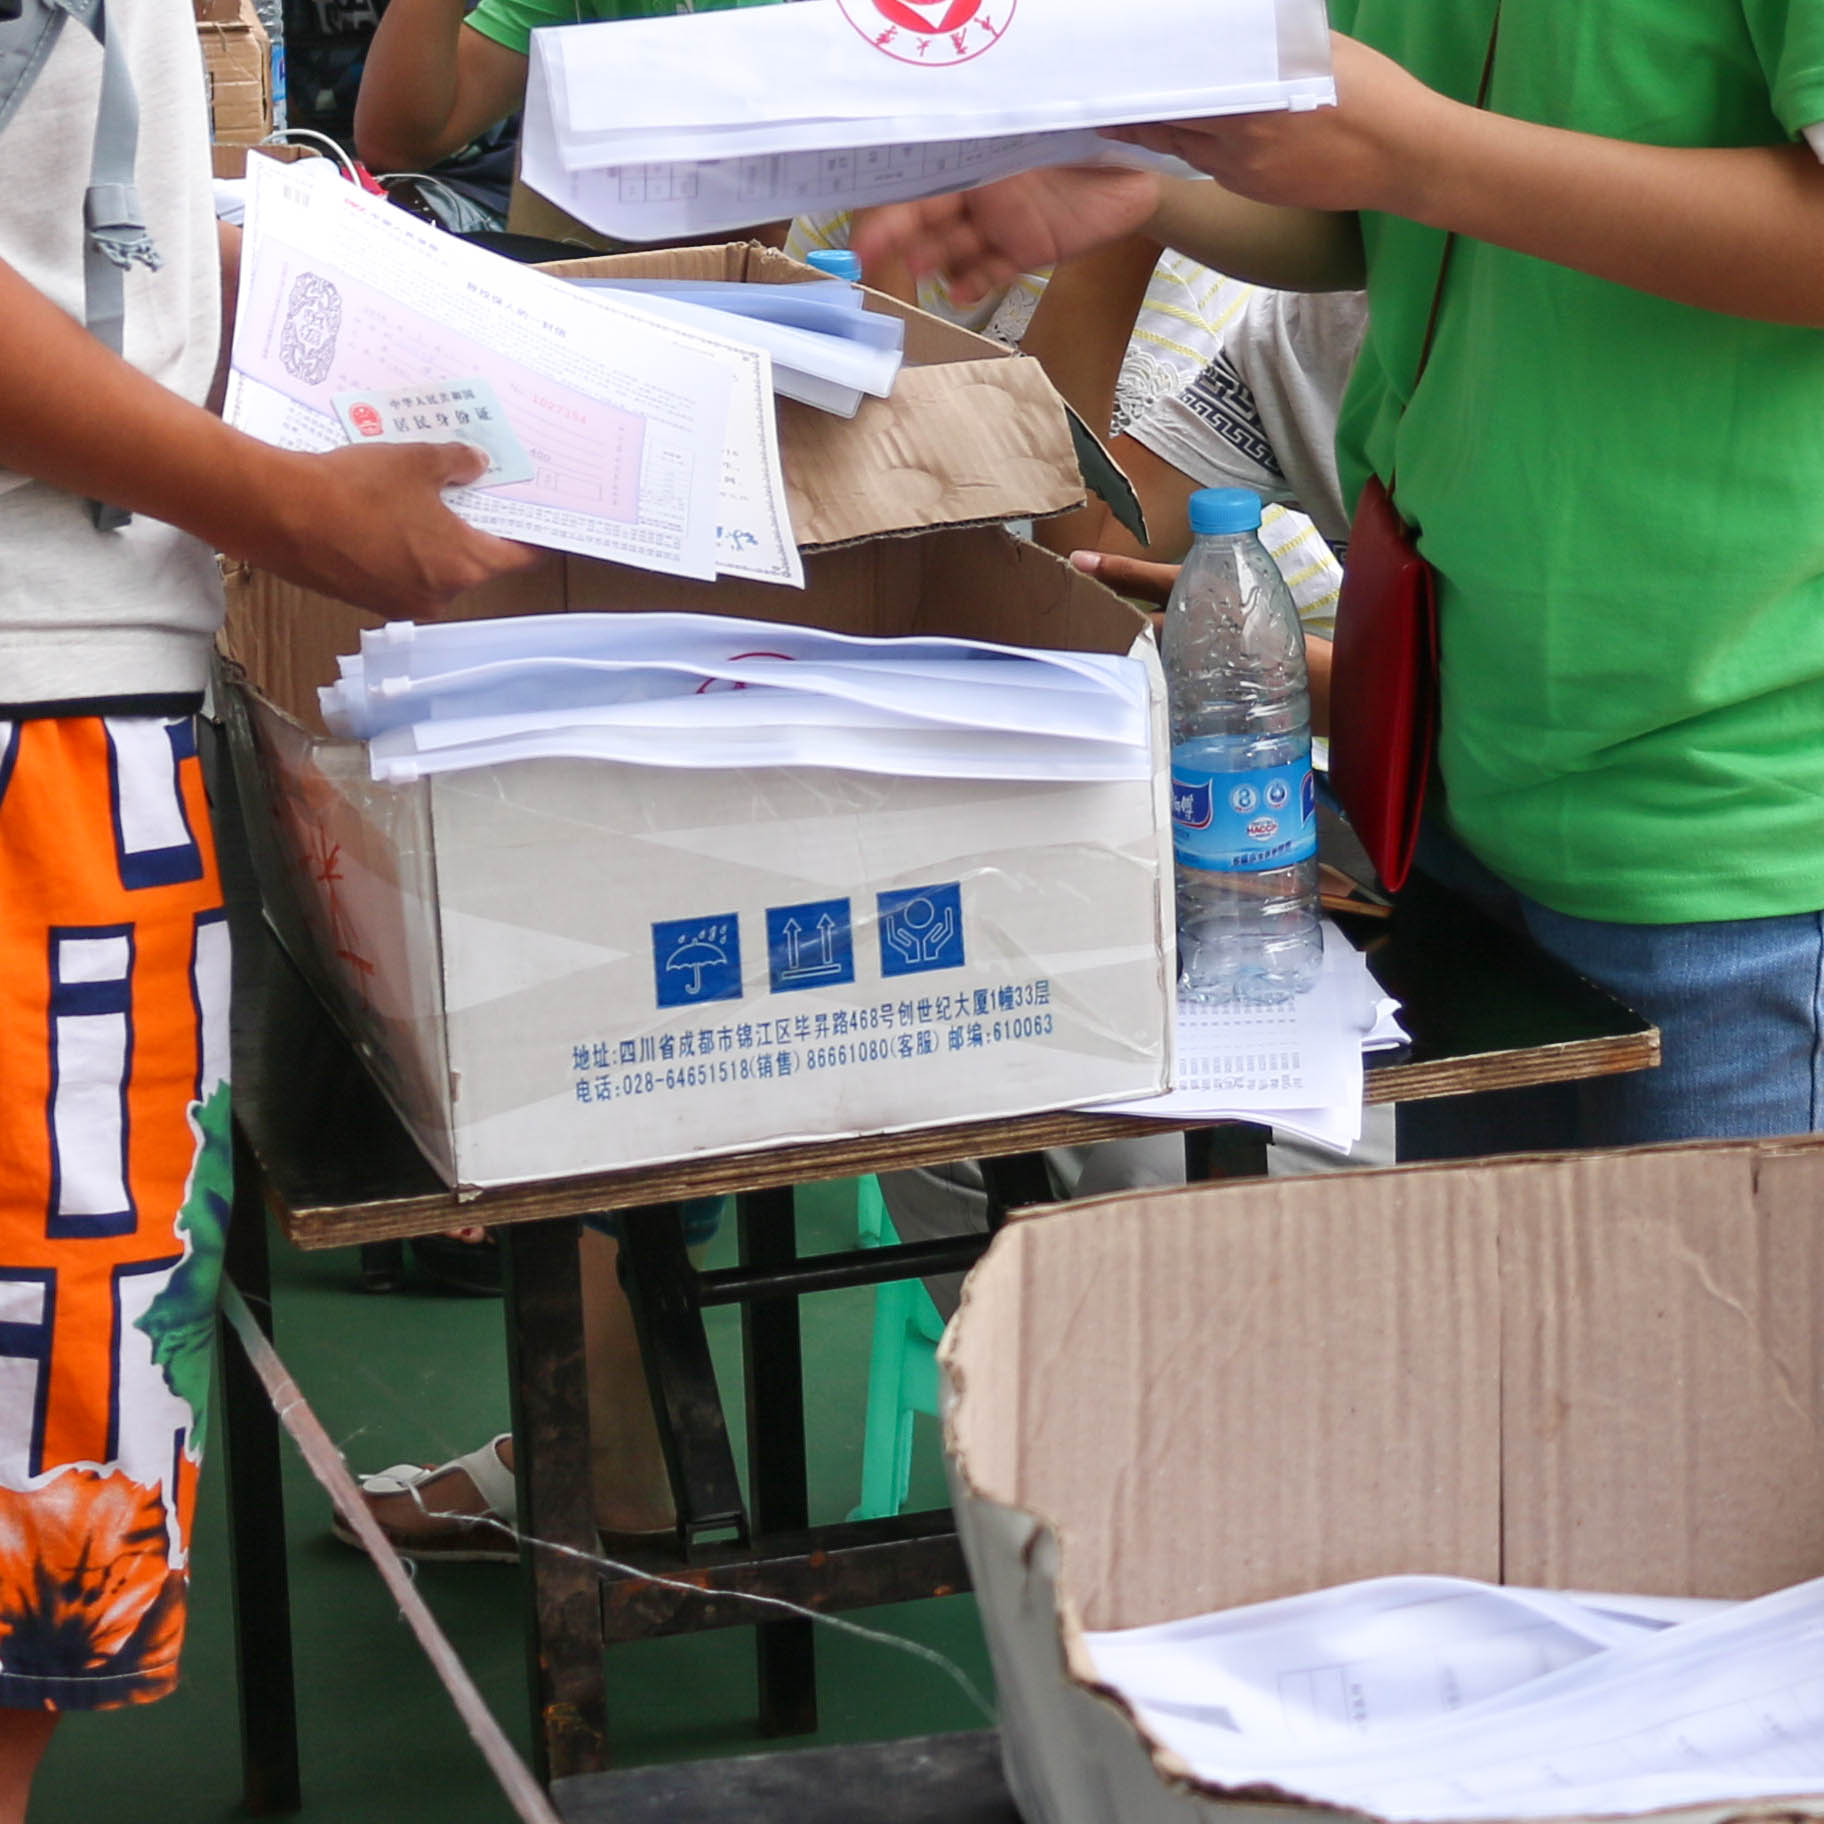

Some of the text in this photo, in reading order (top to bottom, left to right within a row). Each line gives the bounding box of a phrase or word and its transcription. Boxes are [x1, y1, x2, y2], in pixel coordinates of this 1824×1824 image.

[392, 406, 494, 433] 居民身份证
